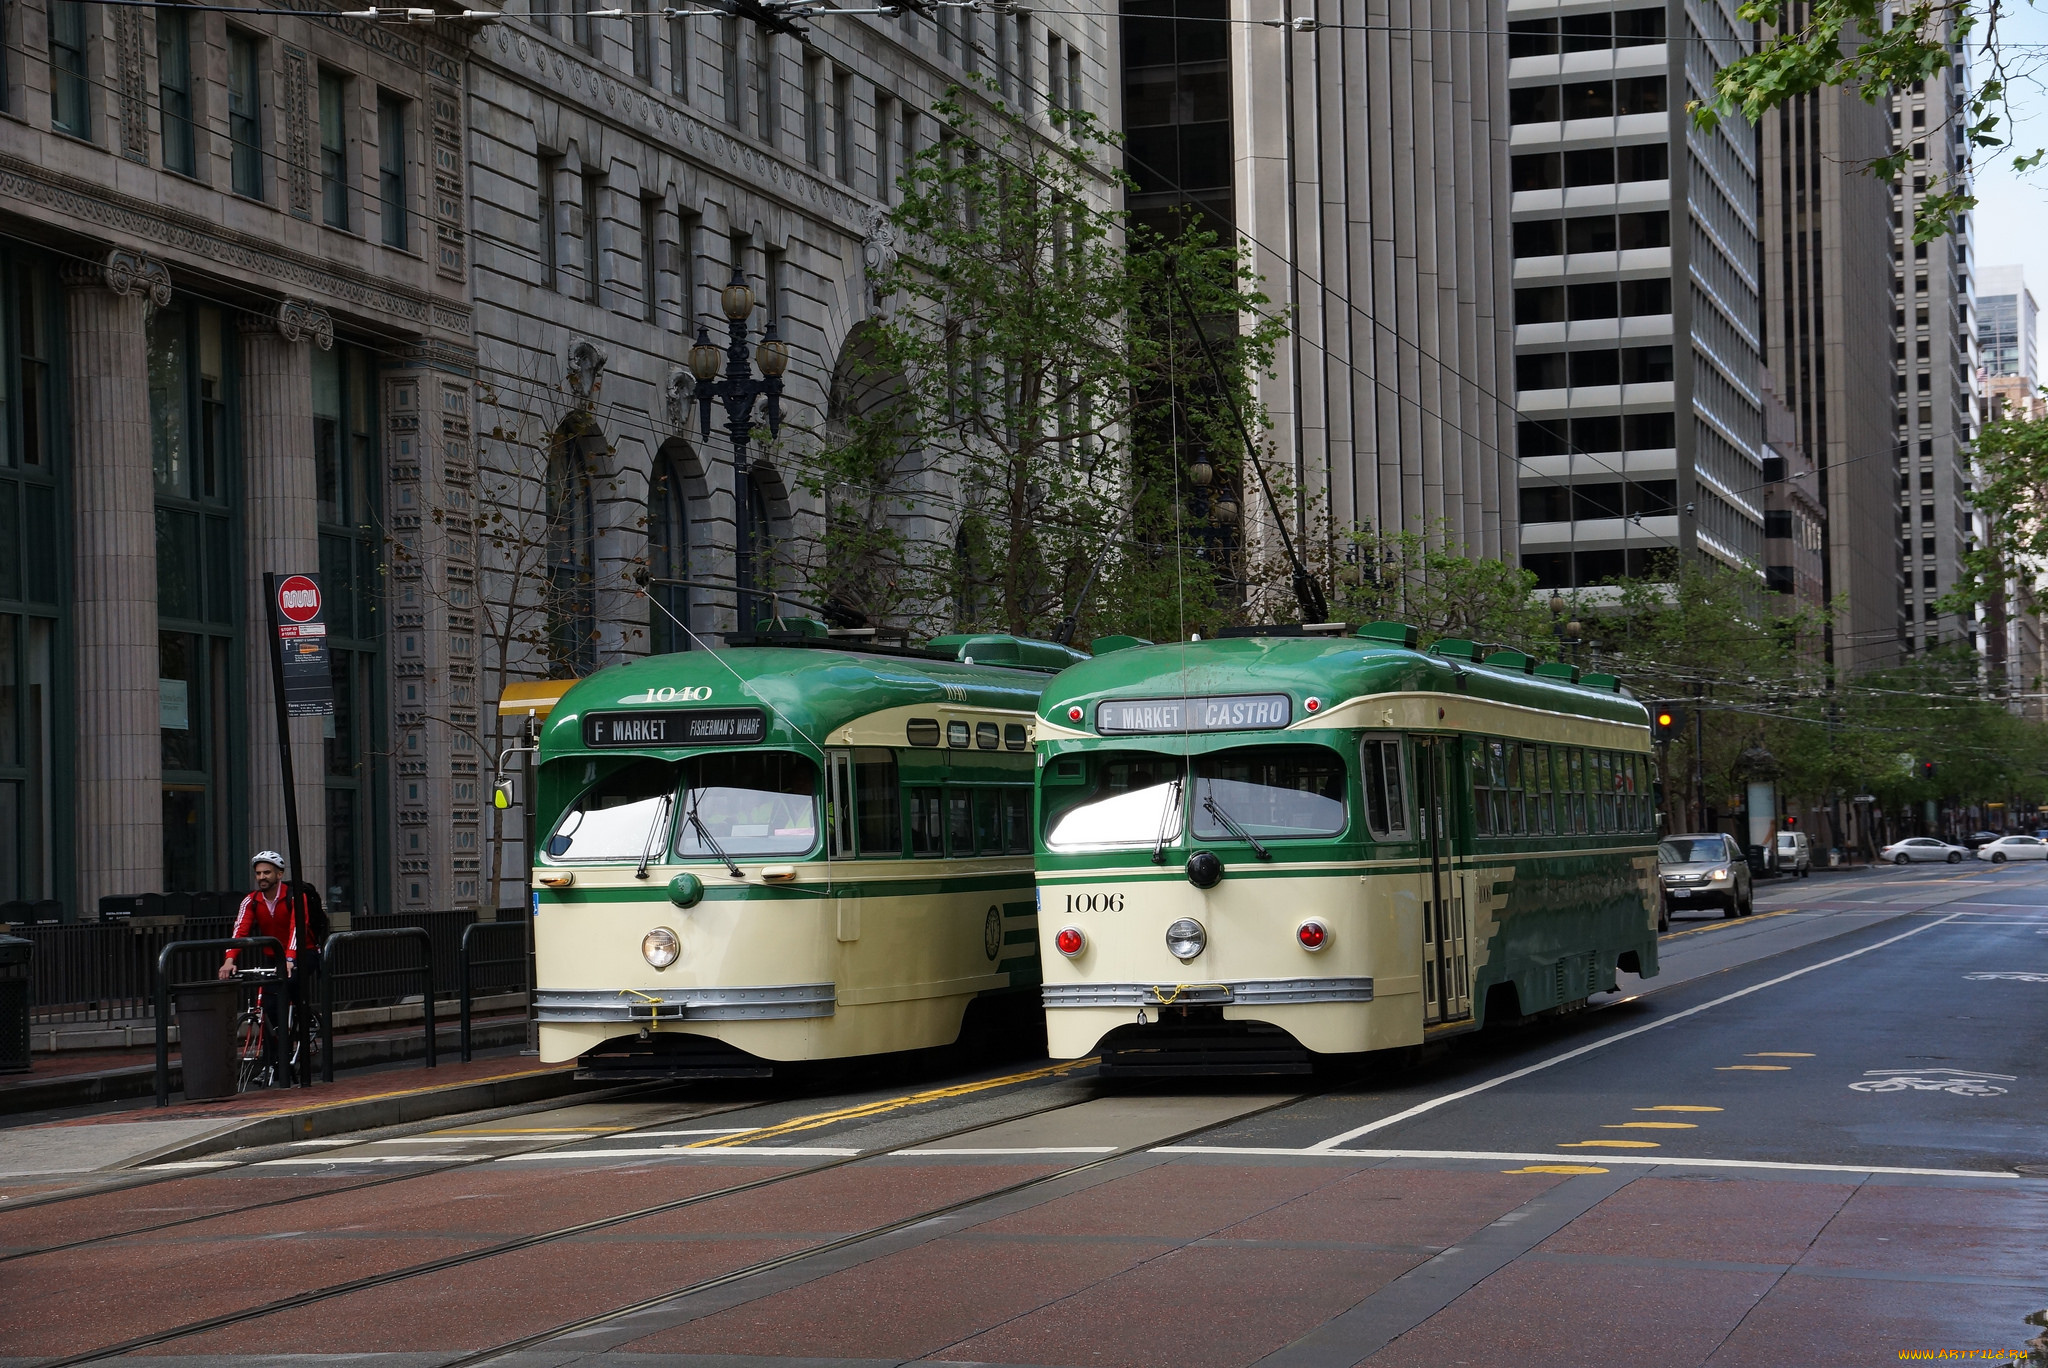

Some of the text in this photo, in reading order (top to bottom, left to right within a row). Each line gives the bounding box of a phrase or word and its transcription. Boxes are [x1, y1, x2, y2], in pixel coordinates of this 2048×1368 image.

[645, 686, 713, 703] 1040
[1103, 701, 1283, 729] F MARKET CASTRO
[595, 718, 761, 742] F MARKET FISHERMAN'S WHARF
[1064, 892, 1125, 914] 1006
